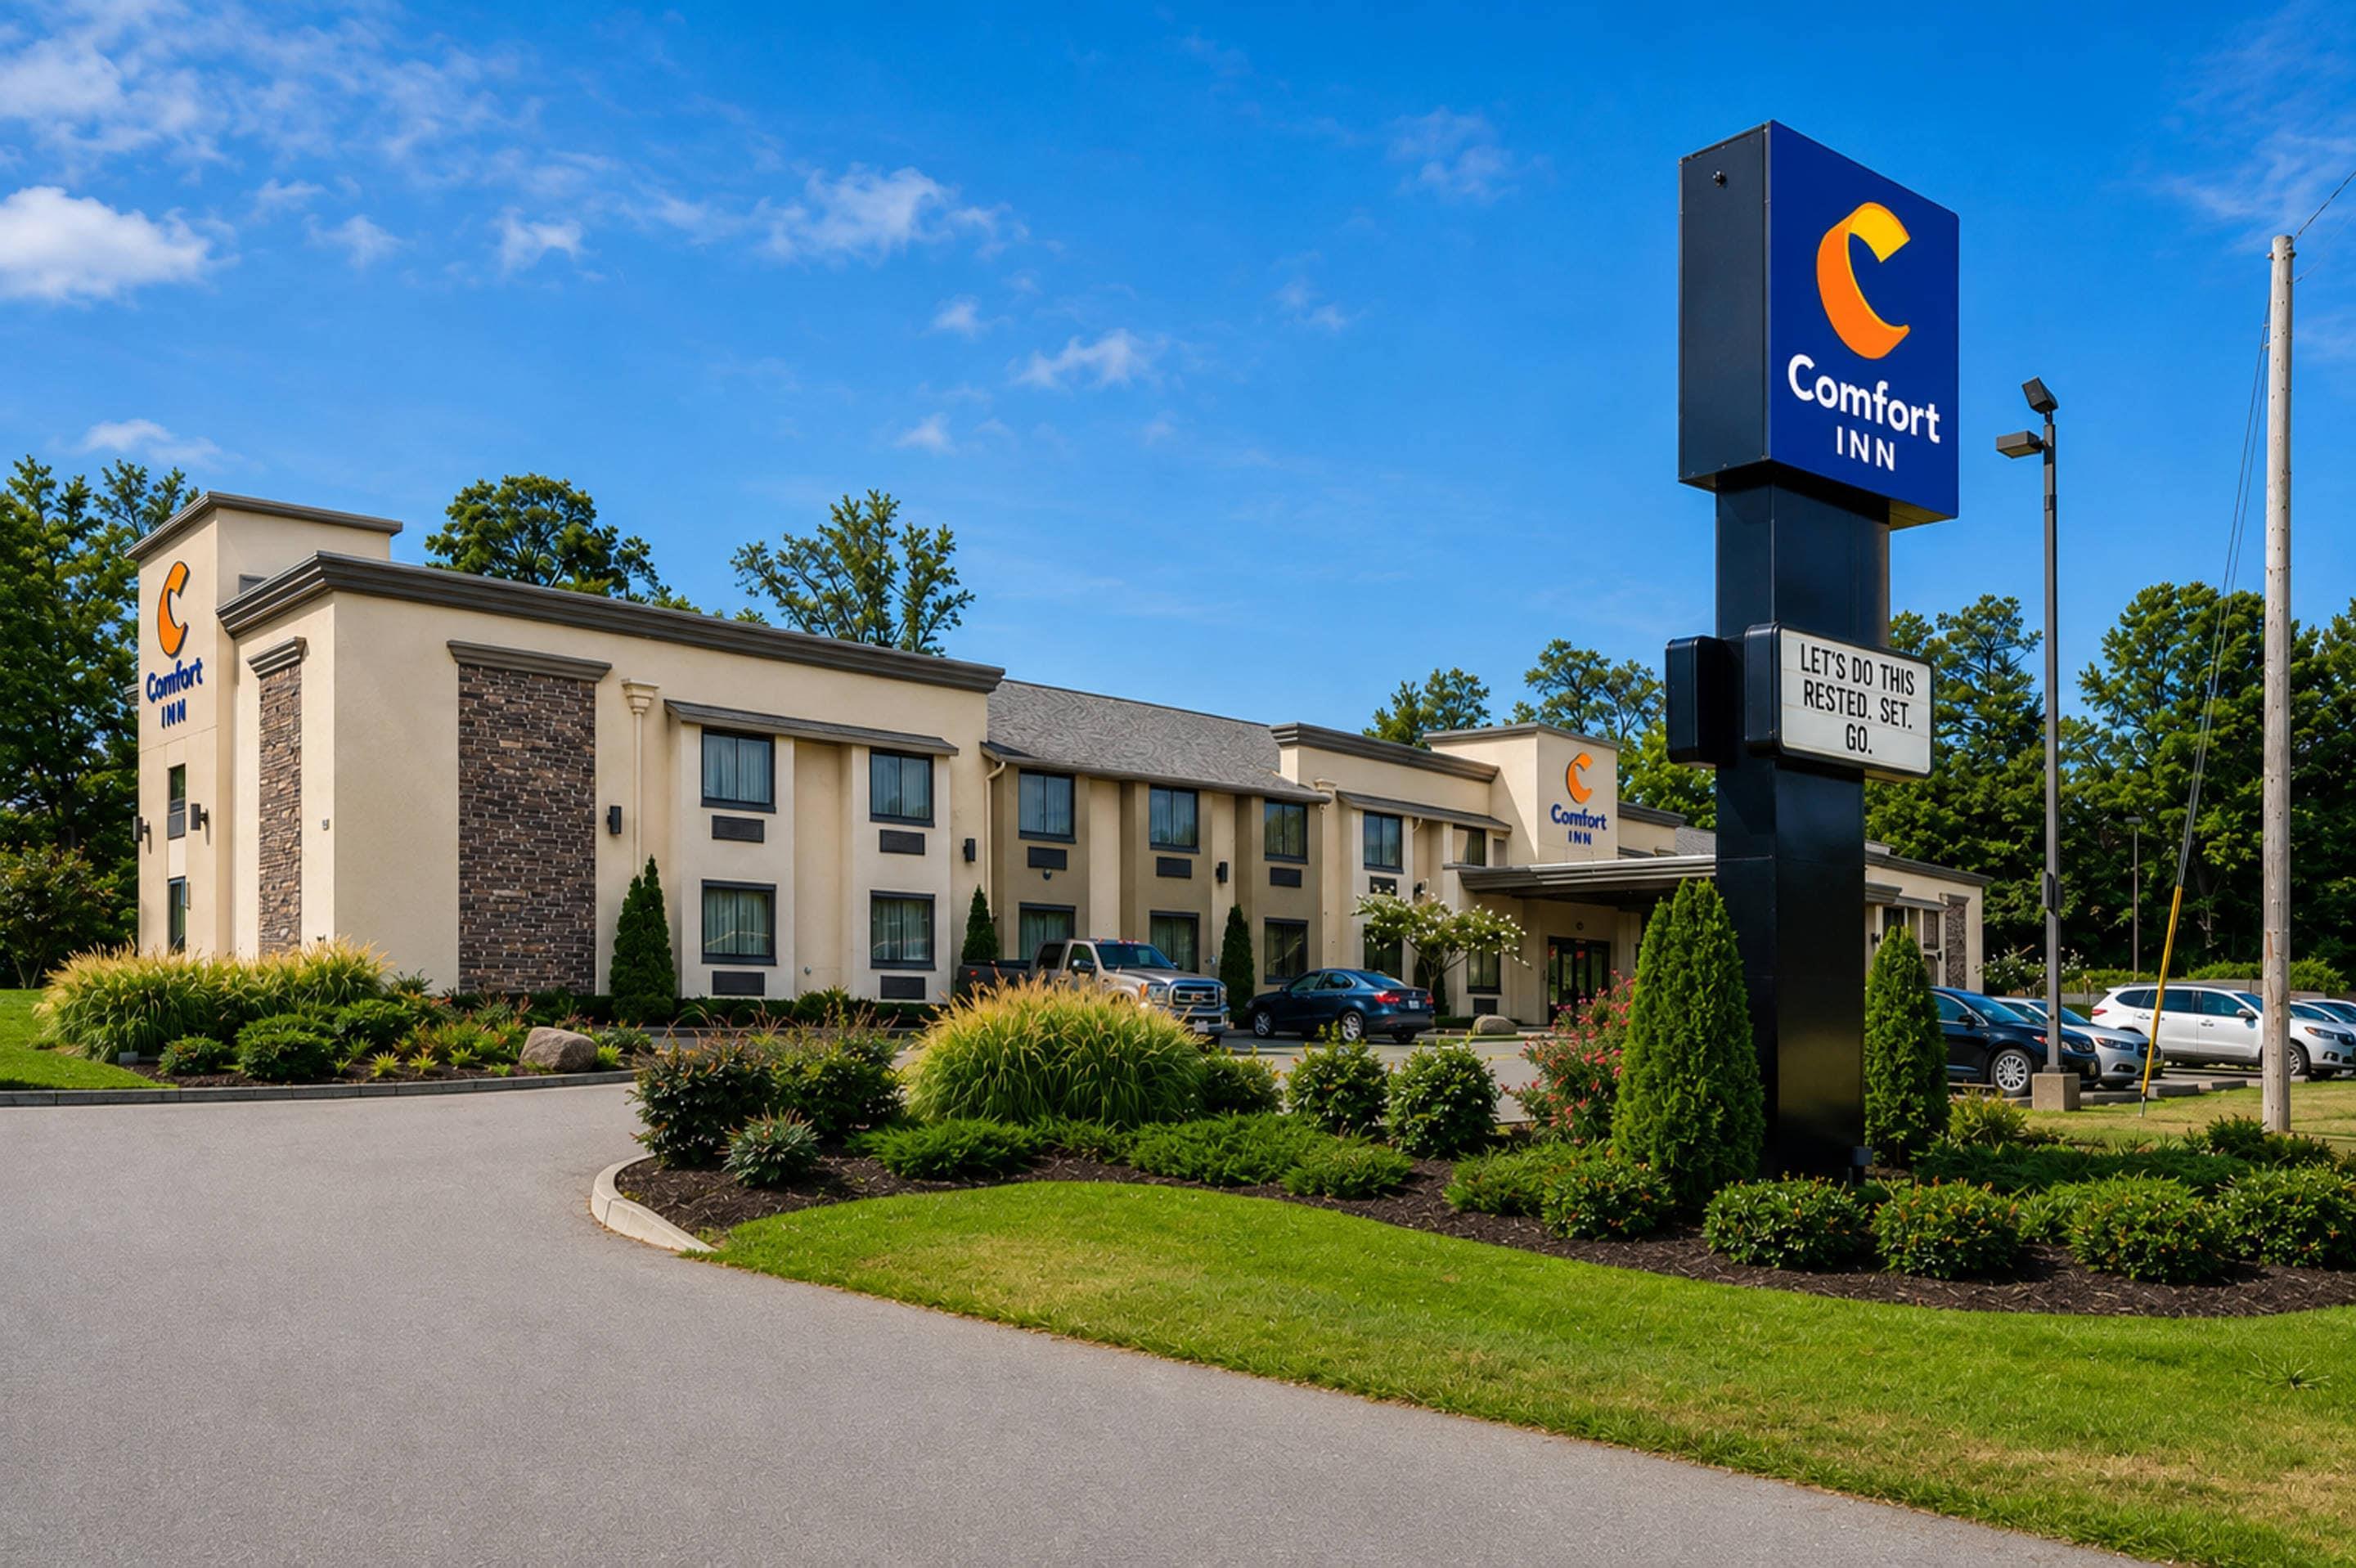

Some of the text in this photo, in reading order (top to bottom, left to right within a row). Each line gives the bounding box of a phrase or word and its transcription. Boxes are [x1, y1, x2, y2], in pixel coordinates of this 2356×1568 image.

[1787, 353, 1940, 443] Comfort
[1837, 425, 1895, 472] INN
[146, 658, 203, 703] Comfort
[1801, 643, 1914, 695] LET'S DO THIS
[162, 699, 186, 729] INN
[1804, 680, 1912, 729] RESTED. SET.
[1846, 723, 1872, 754] GO.
[1551, 803, 1607, 830] Comfort
[1568, 830, 1591, 845] INN
